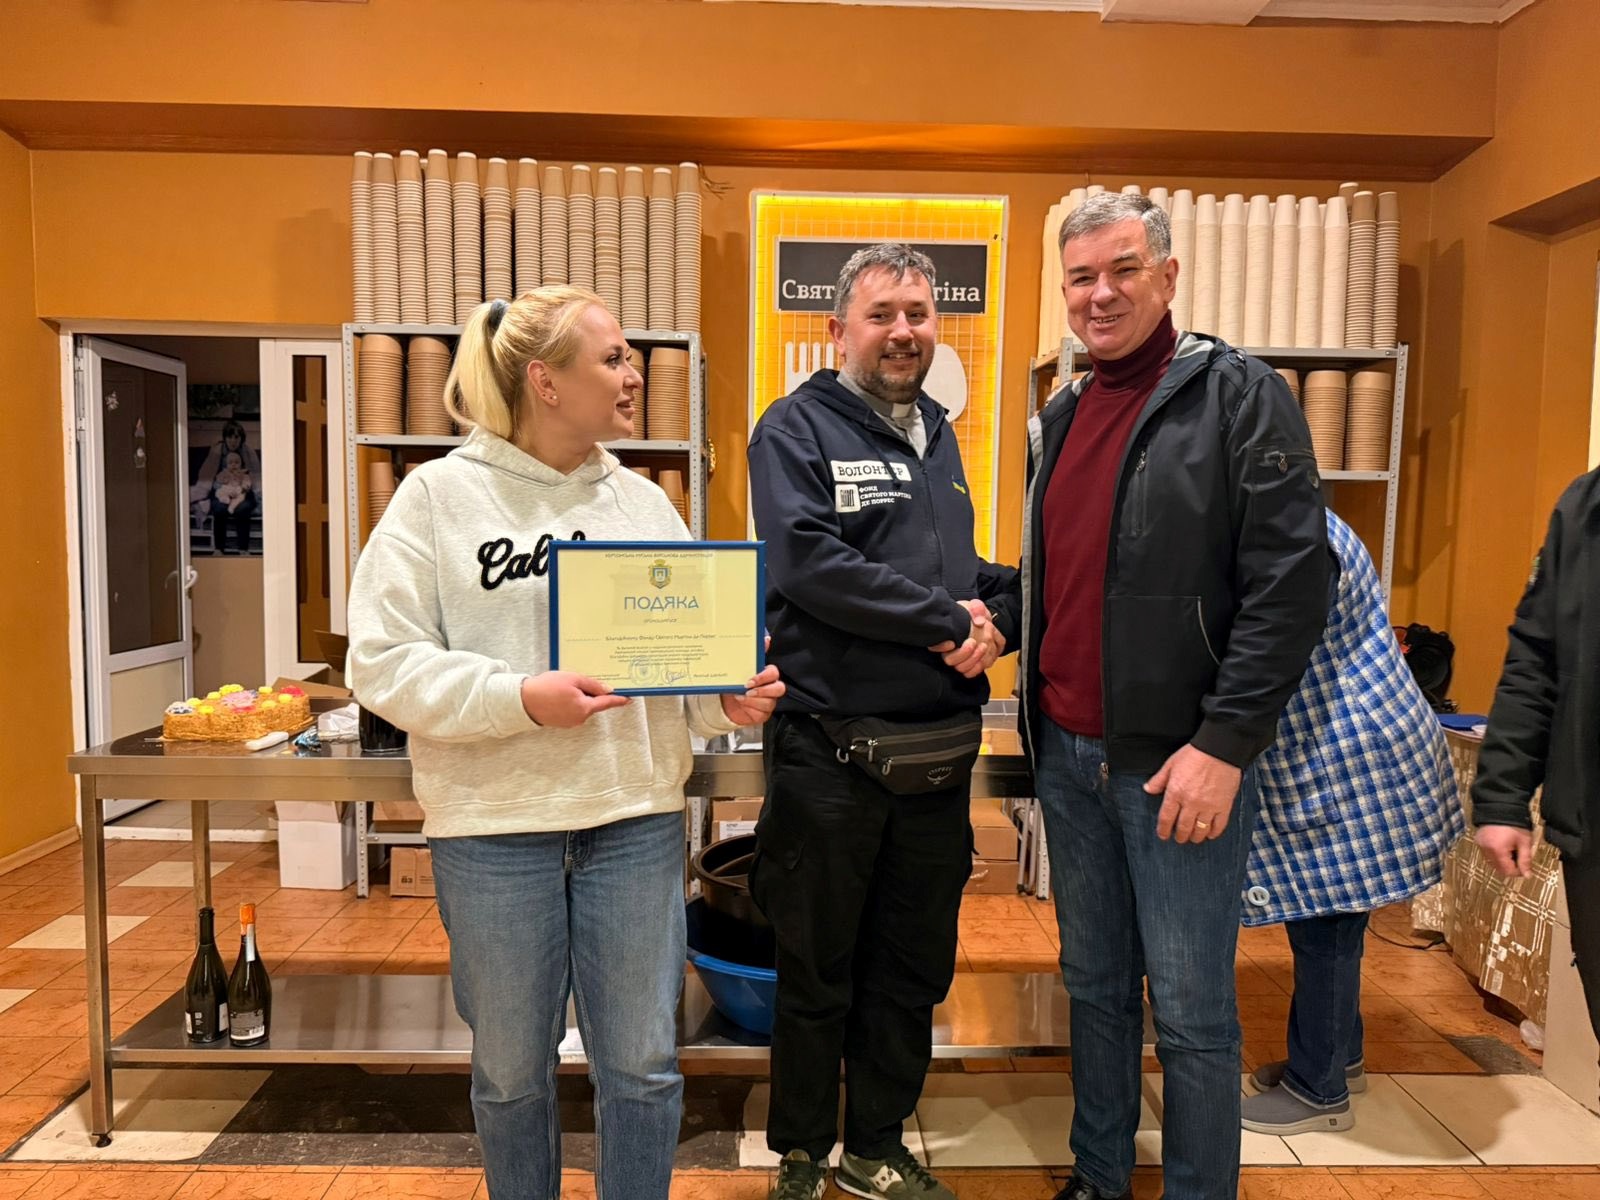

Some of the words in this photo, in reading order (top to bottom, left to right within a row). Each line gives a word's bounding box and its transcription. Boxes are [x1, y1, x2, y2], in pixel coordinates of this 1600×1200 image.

[782, 279, 836, 300] Свят
[933, 281, 981, 302] тіна
[837, 465, 904, 477] ВОЛОНТР
[624, 596, 700, 611] ПОДЯКА
